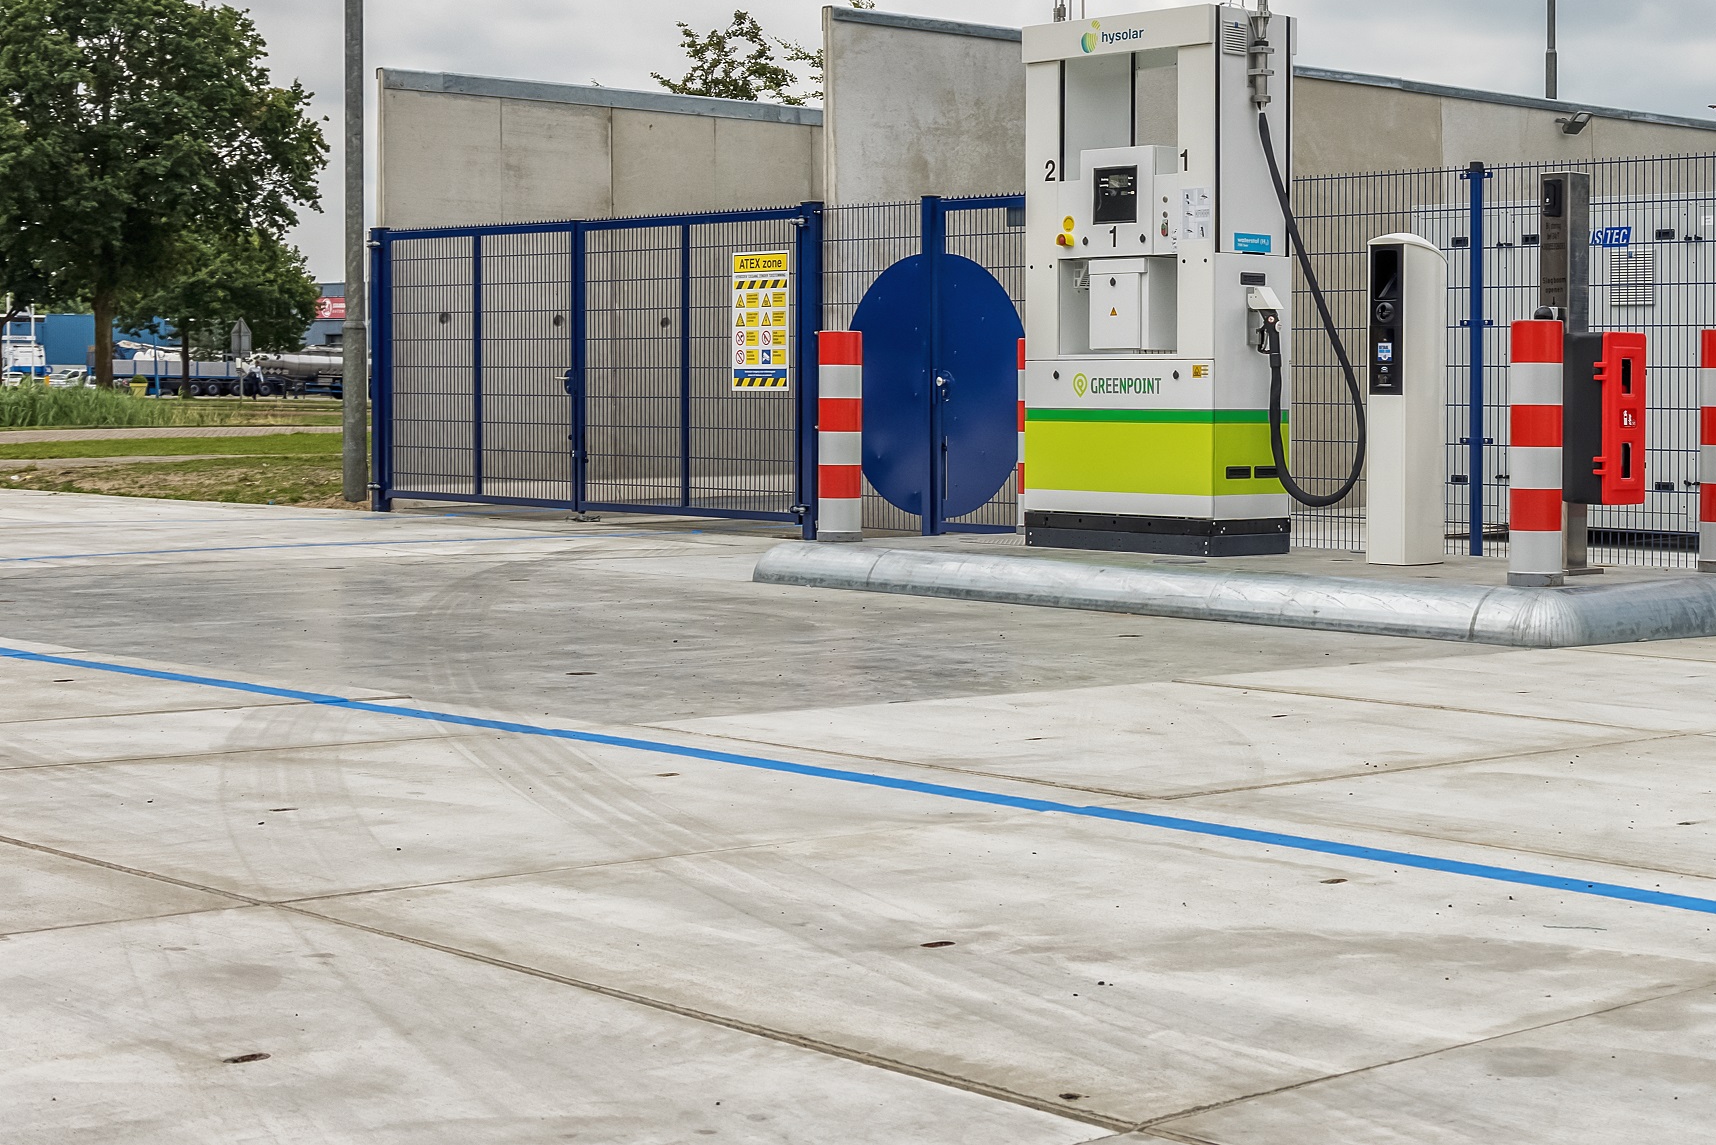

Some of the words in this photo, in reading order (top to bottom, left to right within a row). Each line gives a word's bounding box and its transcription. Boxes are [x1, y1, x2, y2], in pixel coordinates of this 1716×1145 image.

[1102, 29, 1144, 44] hysolar
[1180, 149, 1188, 171] 1
[1044, 159, 1056, 181] 2
[1109, 225, 1117, 247] 1
[739, 258, 760, 269] ATEX
[762, 259, 782, 268] zone
[1090, 377, 1161, 394] GREENPOINT
